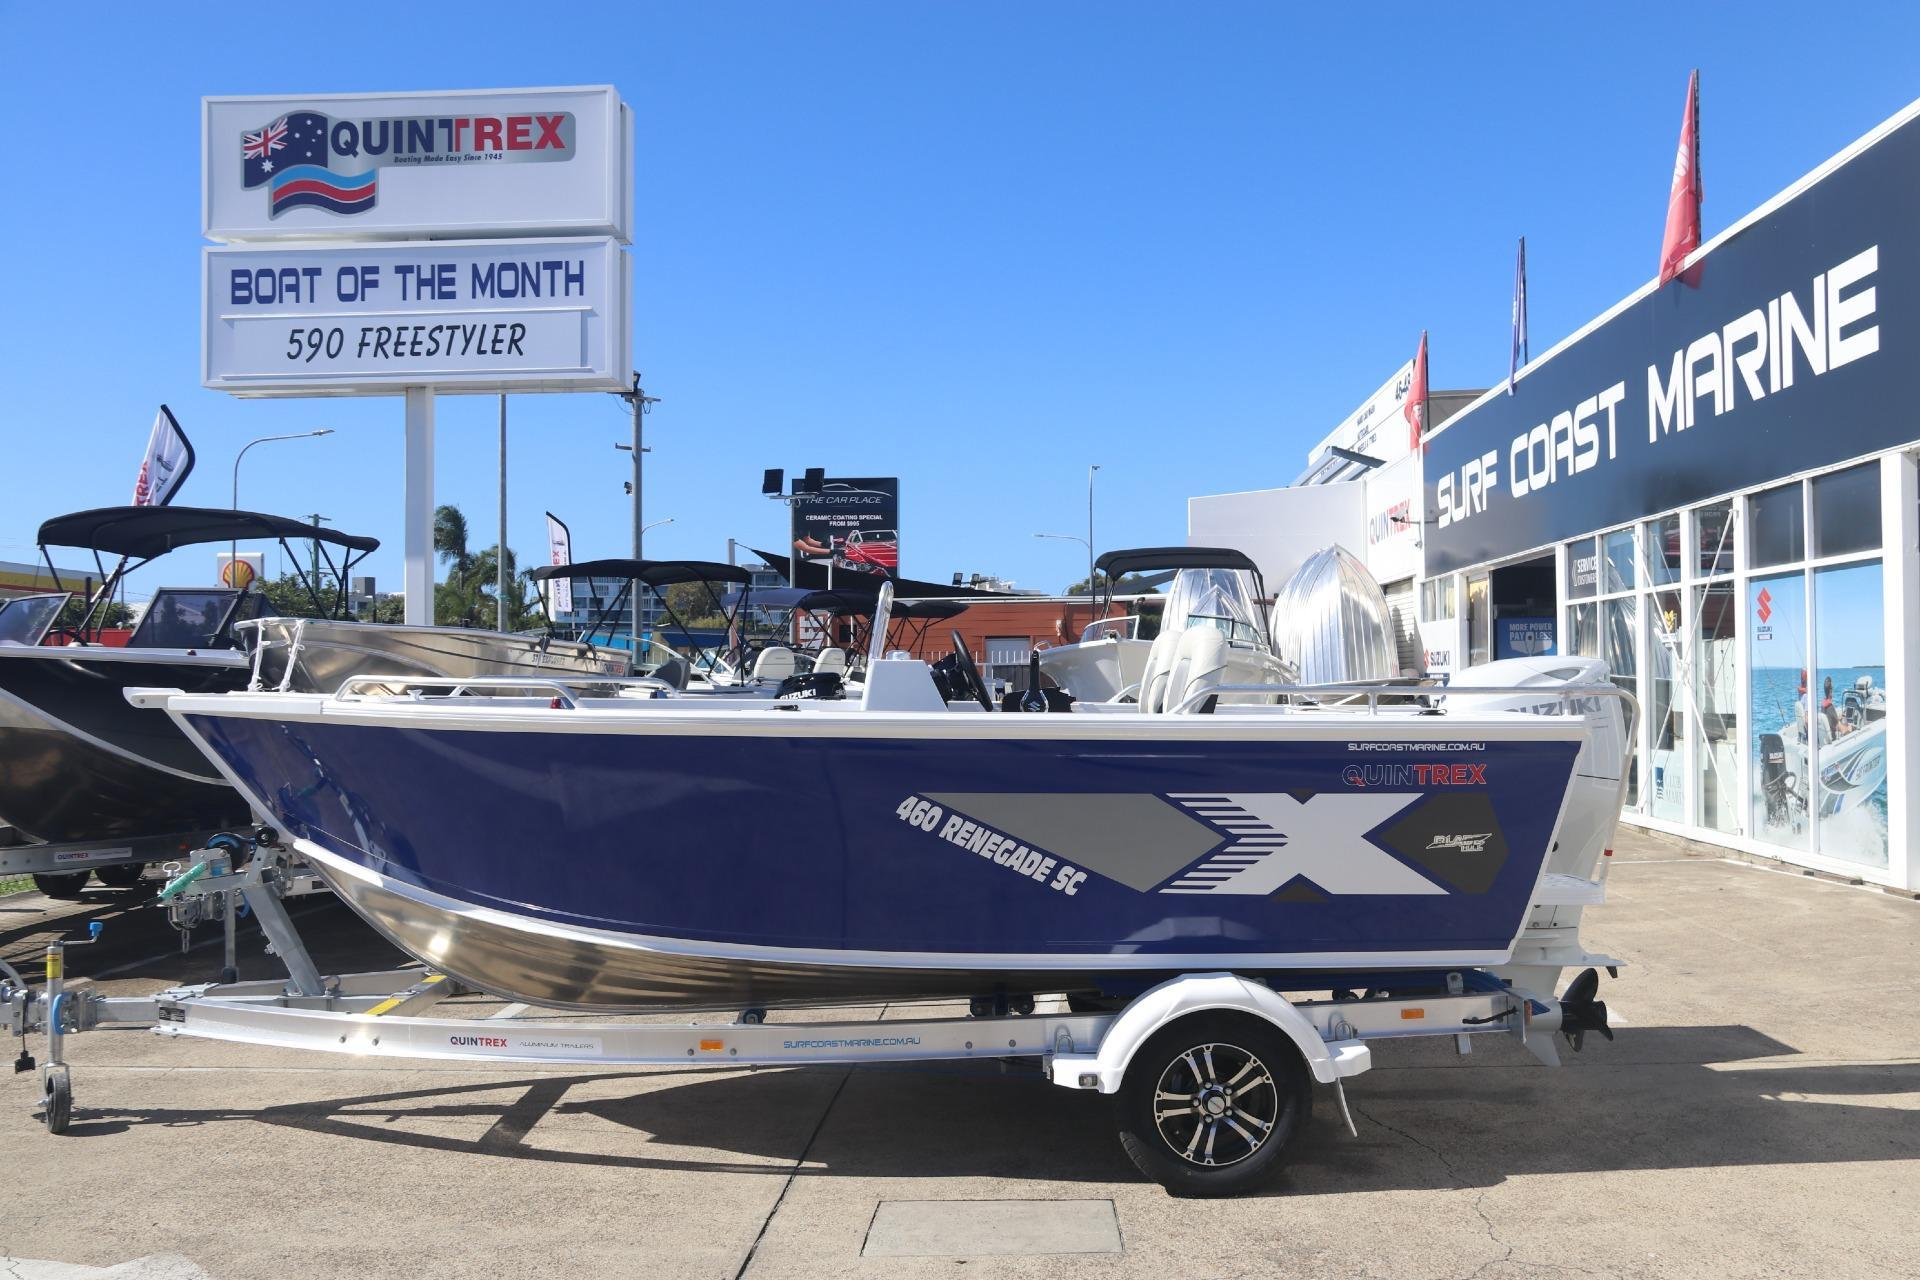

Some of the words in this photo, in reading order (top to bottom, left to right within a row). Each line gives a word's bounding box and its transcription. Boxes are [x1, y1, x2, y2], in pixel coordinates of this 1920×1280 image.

[330, 115, 565, 158] QUINTREX
[394, 156, 422, 164] Boating
[445, 154, 462, 163] Easy
[463, 153, 482, 161] Since
[484, 152, 503, 161] 1945
[231, 267, 322, 305] BOAT
[336, 265, 380, 303] OF
[394, 263, 457, 301] THE
[471, 260, 585, 299] MONTH
[286, 327, 345, 363] 590
[357, 323, 526, 359] FREESTYLER
[1437, 449, 1498, 529] SURF
[1510, 380, 1625, 498] COAST
[1648, 245, 1880, 444] MARINE
[806, 496, 825, 504] THE
[826, 496, 848, 504] CAR
[849, 496, 883, 504] PLACE
[1509, 623, 1528, 631] MORE
[1529, 622, 1553, 631] POWER
[1509, 631, 1525, 641] PAY
[1535, 631, 1553, 640] LESS
[1430, 650, 1450, 666] SUZUKI
[1347, 743, 1485, 751] SURFCOASTMARINE.COM.AU
[1342, 763, 1487, 787] QUINTREX
[895, 795, 943, 832] 460
[938, 814, 1058, 883] RENEGADE
[1050, 865, 1088, 896] SC
[450, 1036, 508, 1047] QUINTREX
[783, 1037, 921, 1049] SURFCOASTMARINE.COM.AU
